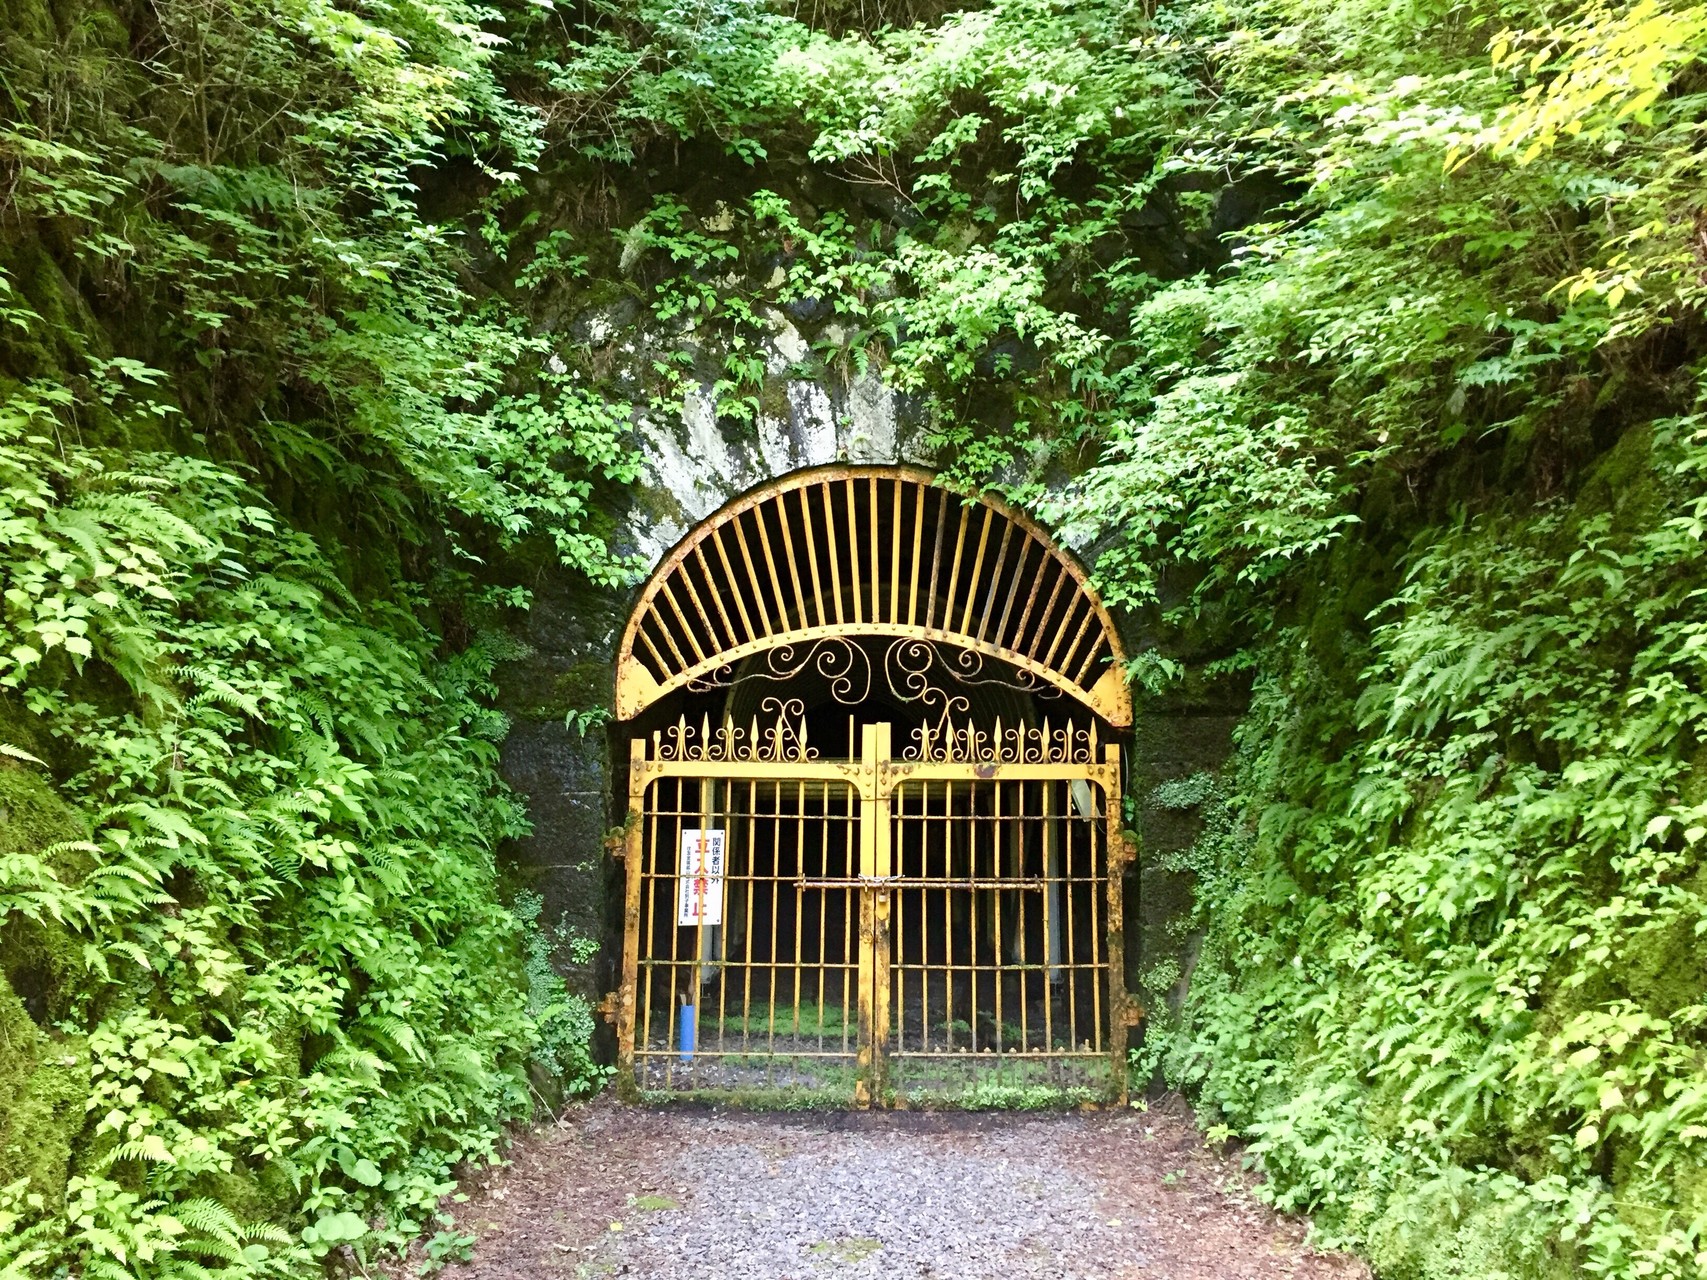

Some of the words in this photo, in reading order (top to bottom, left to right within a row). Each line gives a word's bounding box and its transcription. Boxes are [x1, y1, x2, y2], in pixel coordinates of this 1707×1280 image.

[692, 839, 710, 916] 立入禁止
[711, 837, 721, 884] 関係者以外
